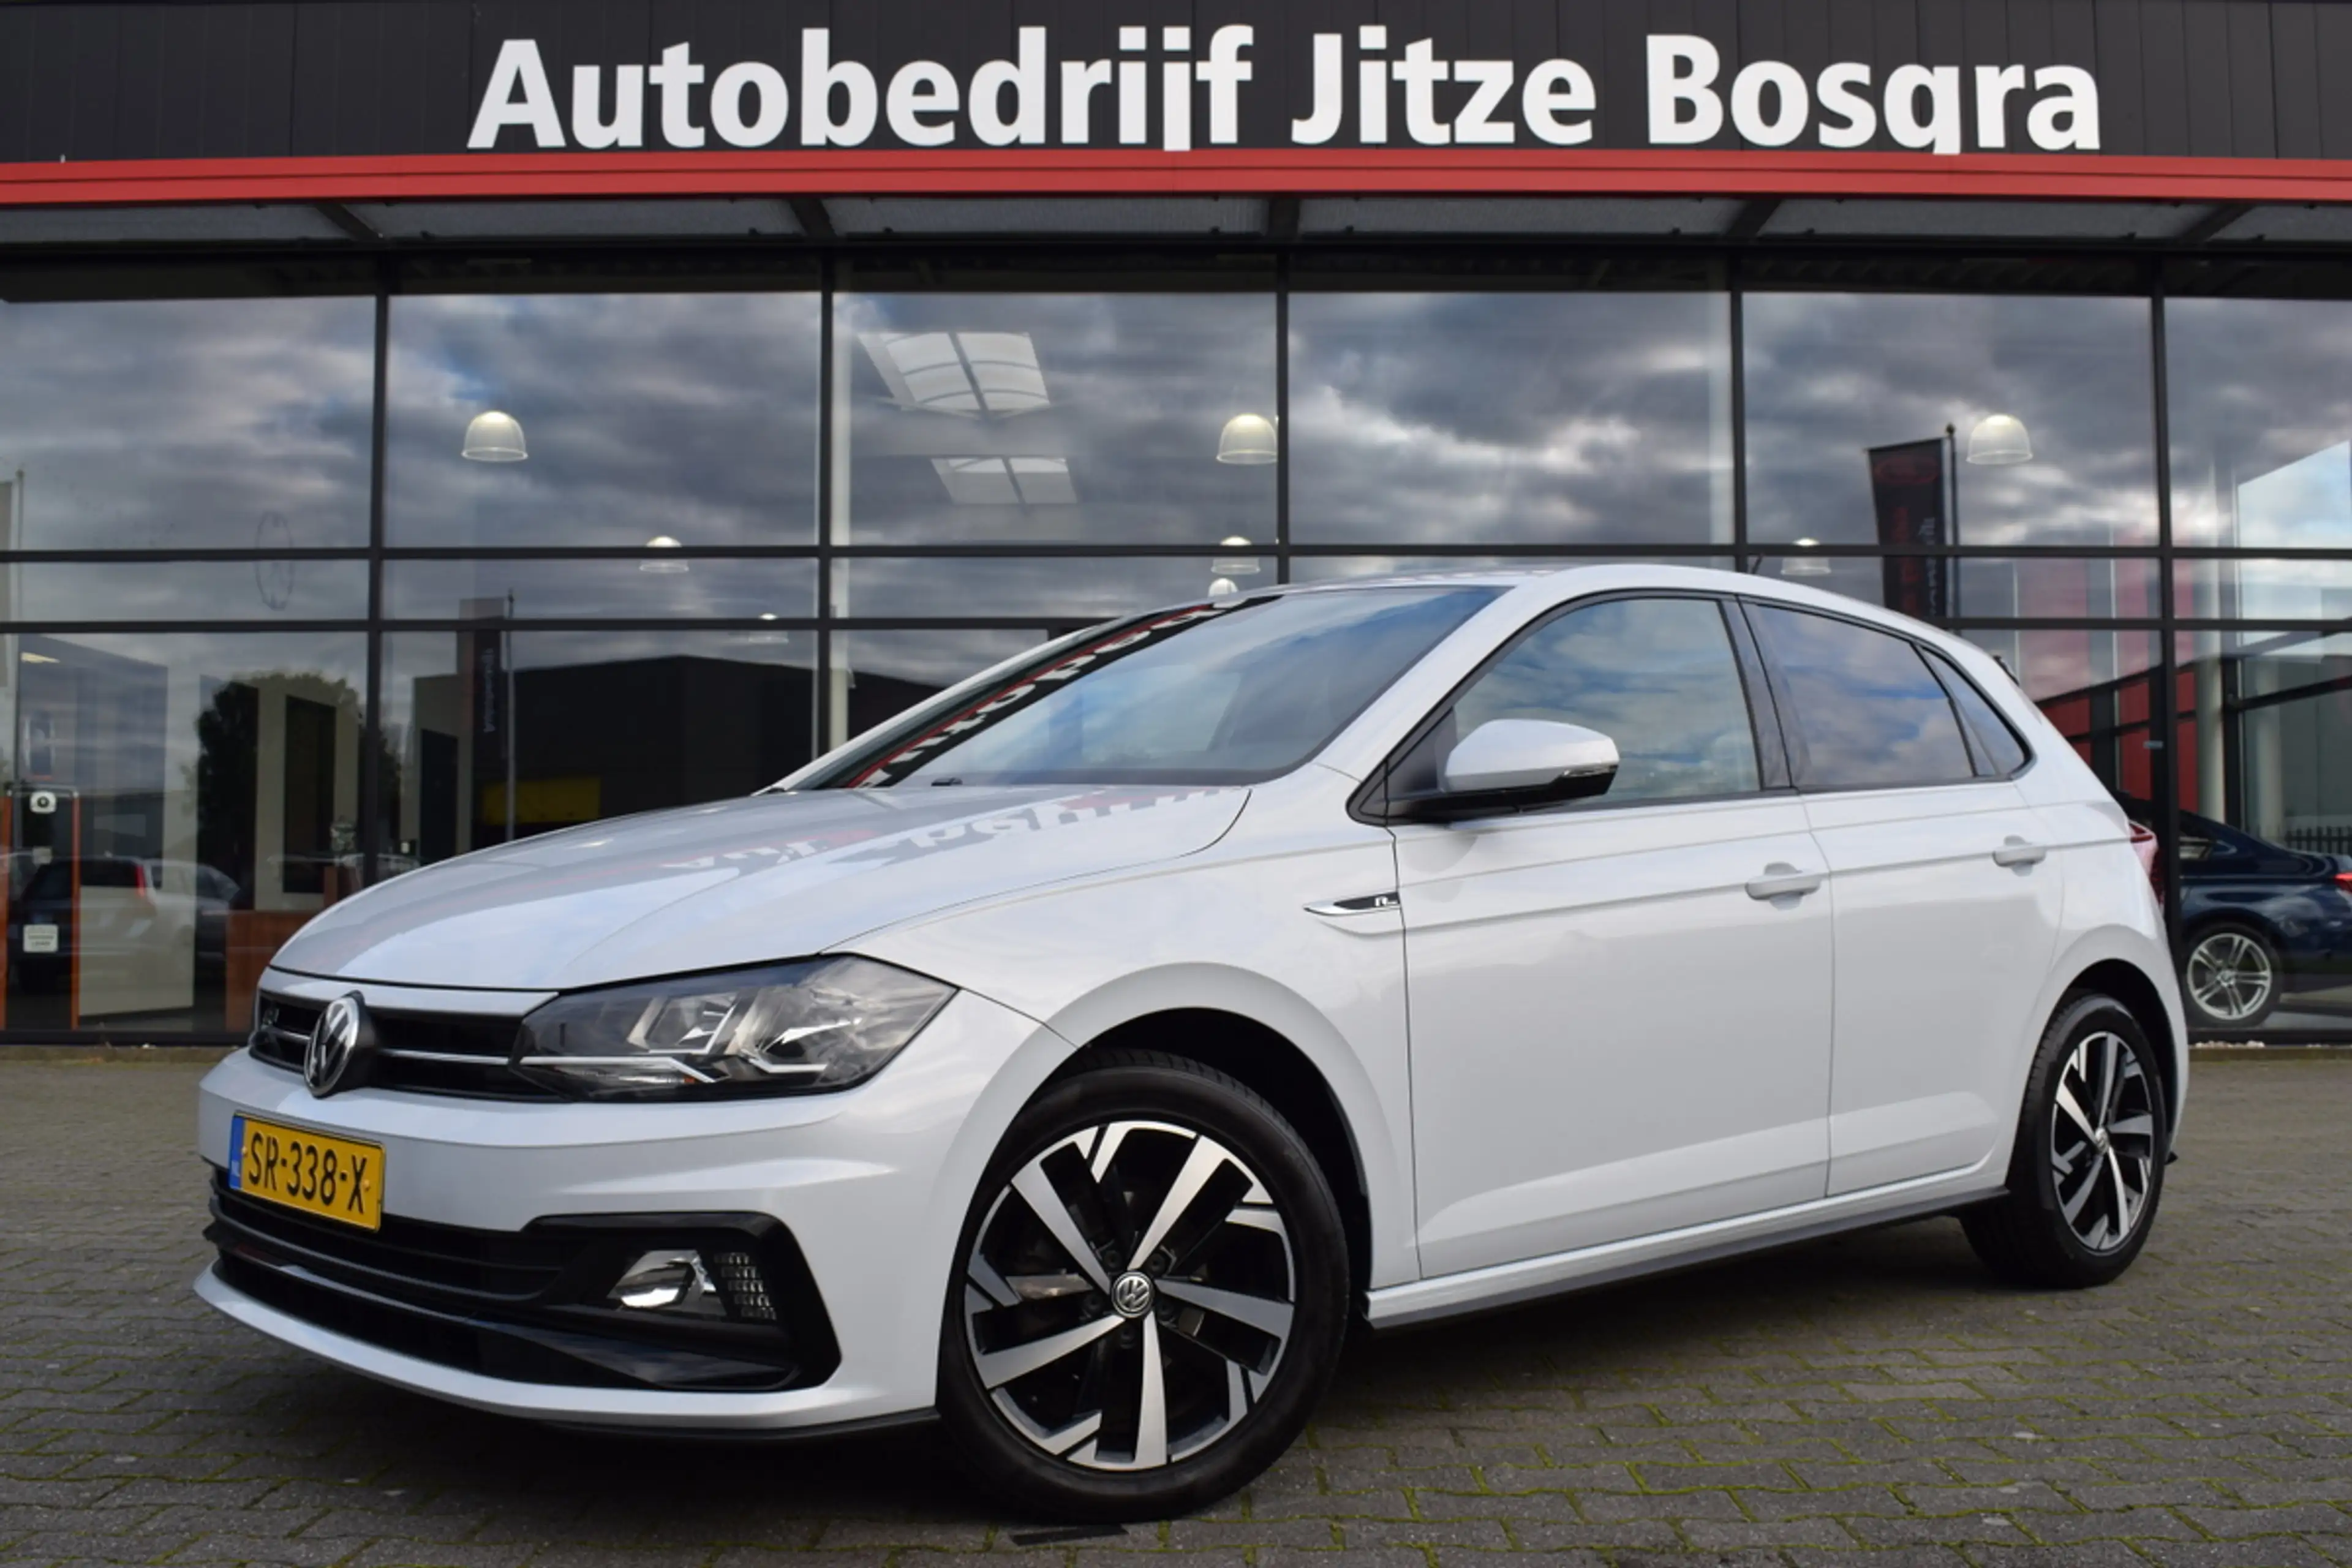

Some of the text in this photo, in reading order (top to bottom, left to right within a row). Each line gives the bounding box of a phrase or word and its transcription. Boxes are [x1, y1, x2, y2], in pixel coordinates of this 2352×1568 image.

[467, 24, 1254, 151] Autobedrijf
[1291, 25, 1596, 145] Jitze
[249, 1131, 367, 1215] SR-338-X
